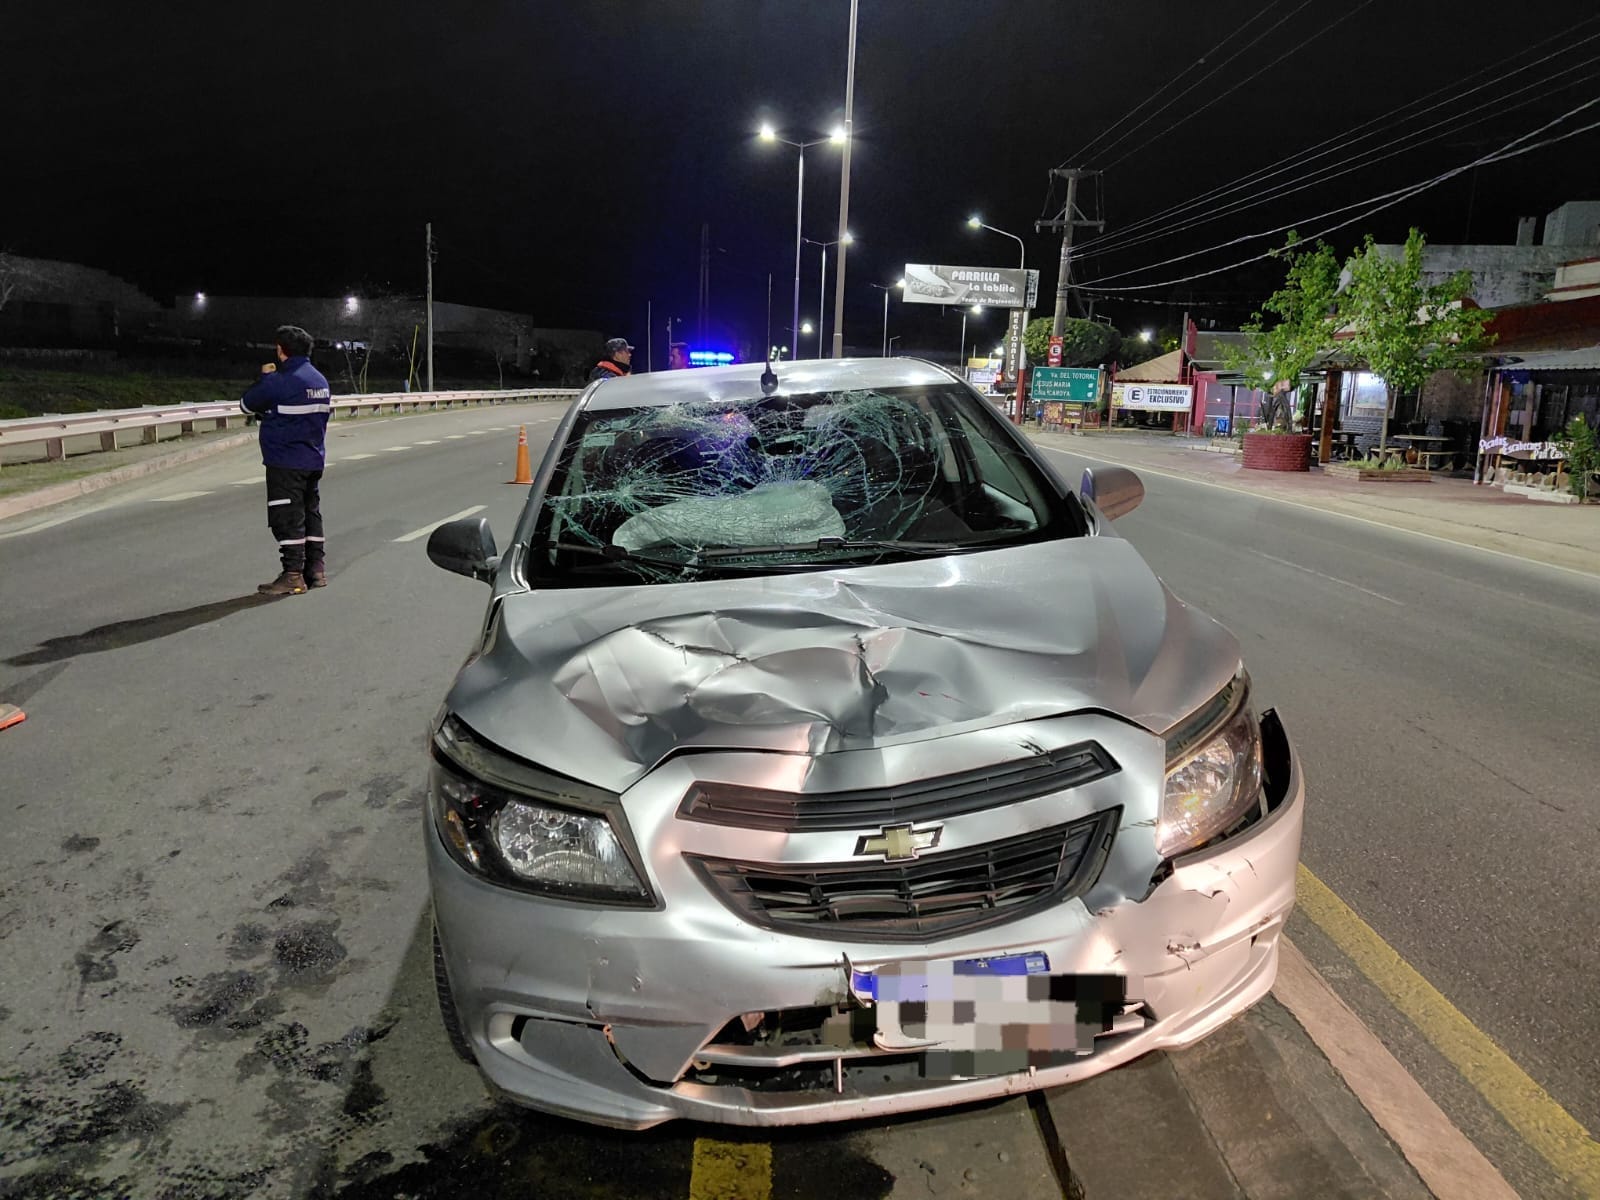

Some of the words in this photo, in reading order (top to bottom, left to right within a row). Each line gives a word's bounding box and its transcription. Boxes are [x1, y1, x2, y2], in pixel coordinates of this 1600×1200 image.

[951, 270, 1000, 282] PARRILLA
[968, 282, 980, 291] La
[1131, 390, 1141, 400] E
[1147, 388, 1188, 396] ESTACIONAMIENTO
[1149, 395, 1185, 404] EXCLUSIVO
